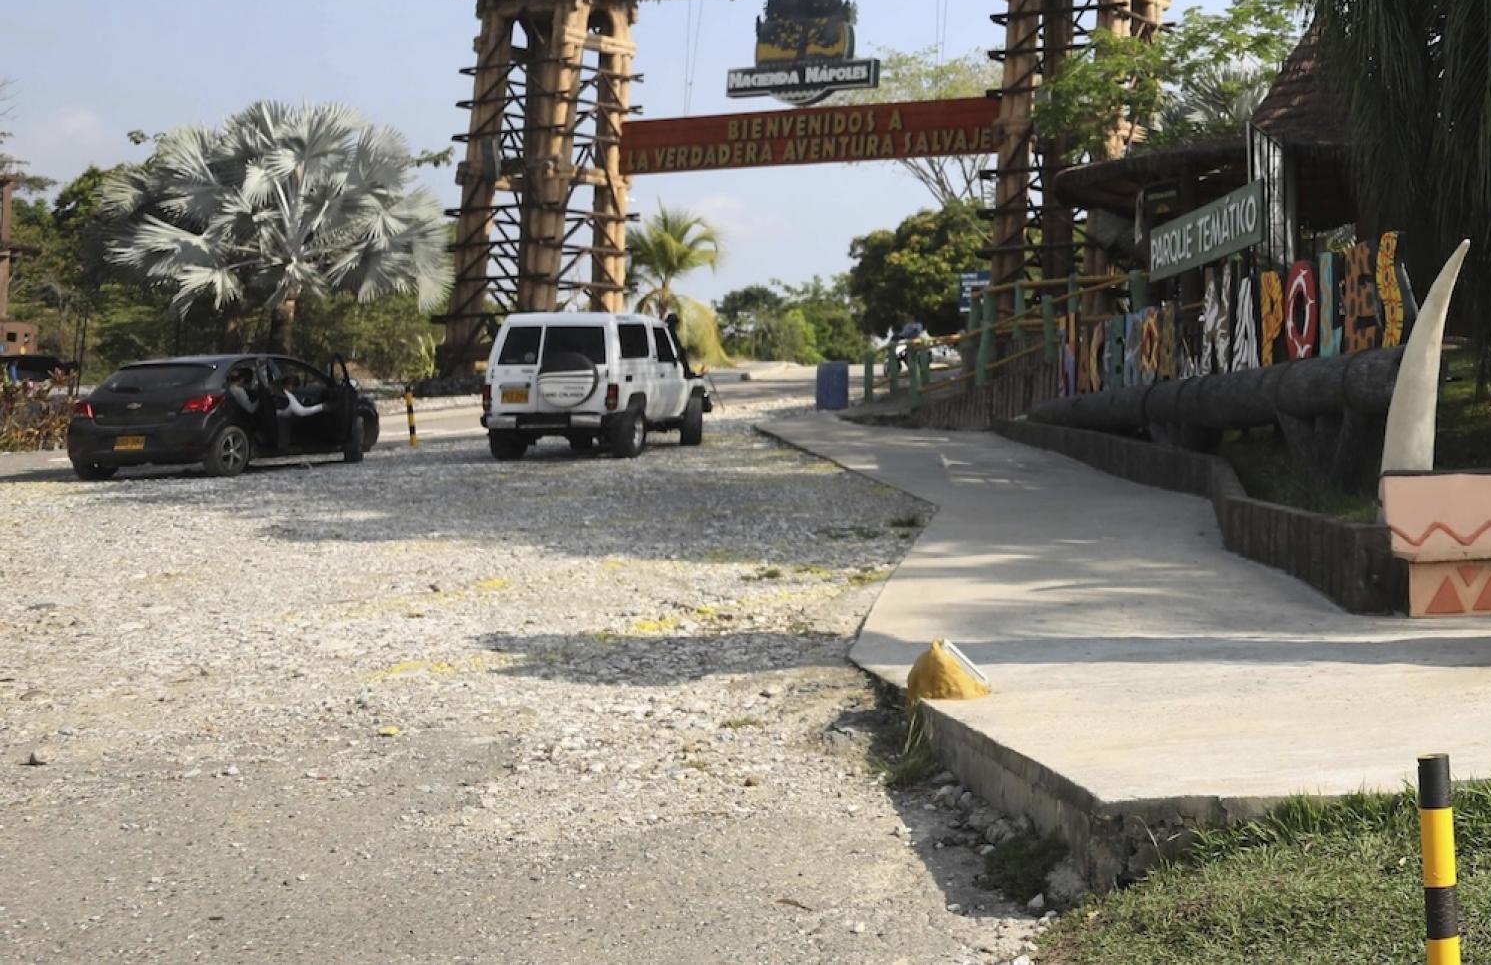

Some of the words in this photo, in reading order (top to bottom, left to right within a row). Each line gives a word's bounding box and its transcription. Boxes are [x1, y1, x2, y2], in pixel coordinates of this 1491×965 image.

[728, 70, 800, 89] HACIENDA
[727, 109, 876, 141] BIENVENIDOS
[889, 108, 903, 131] A
[627, 149, 649, 171] LA
[655, 140, 773, 169] VERDADERA
[783, 133, 895, 162] AVENTURA
[903, 126, 992, 155] SALVAJE
[1150, 222, 1193, 272] PARQUE
[1196, 194, 1258, 254] TEMÁTICO
